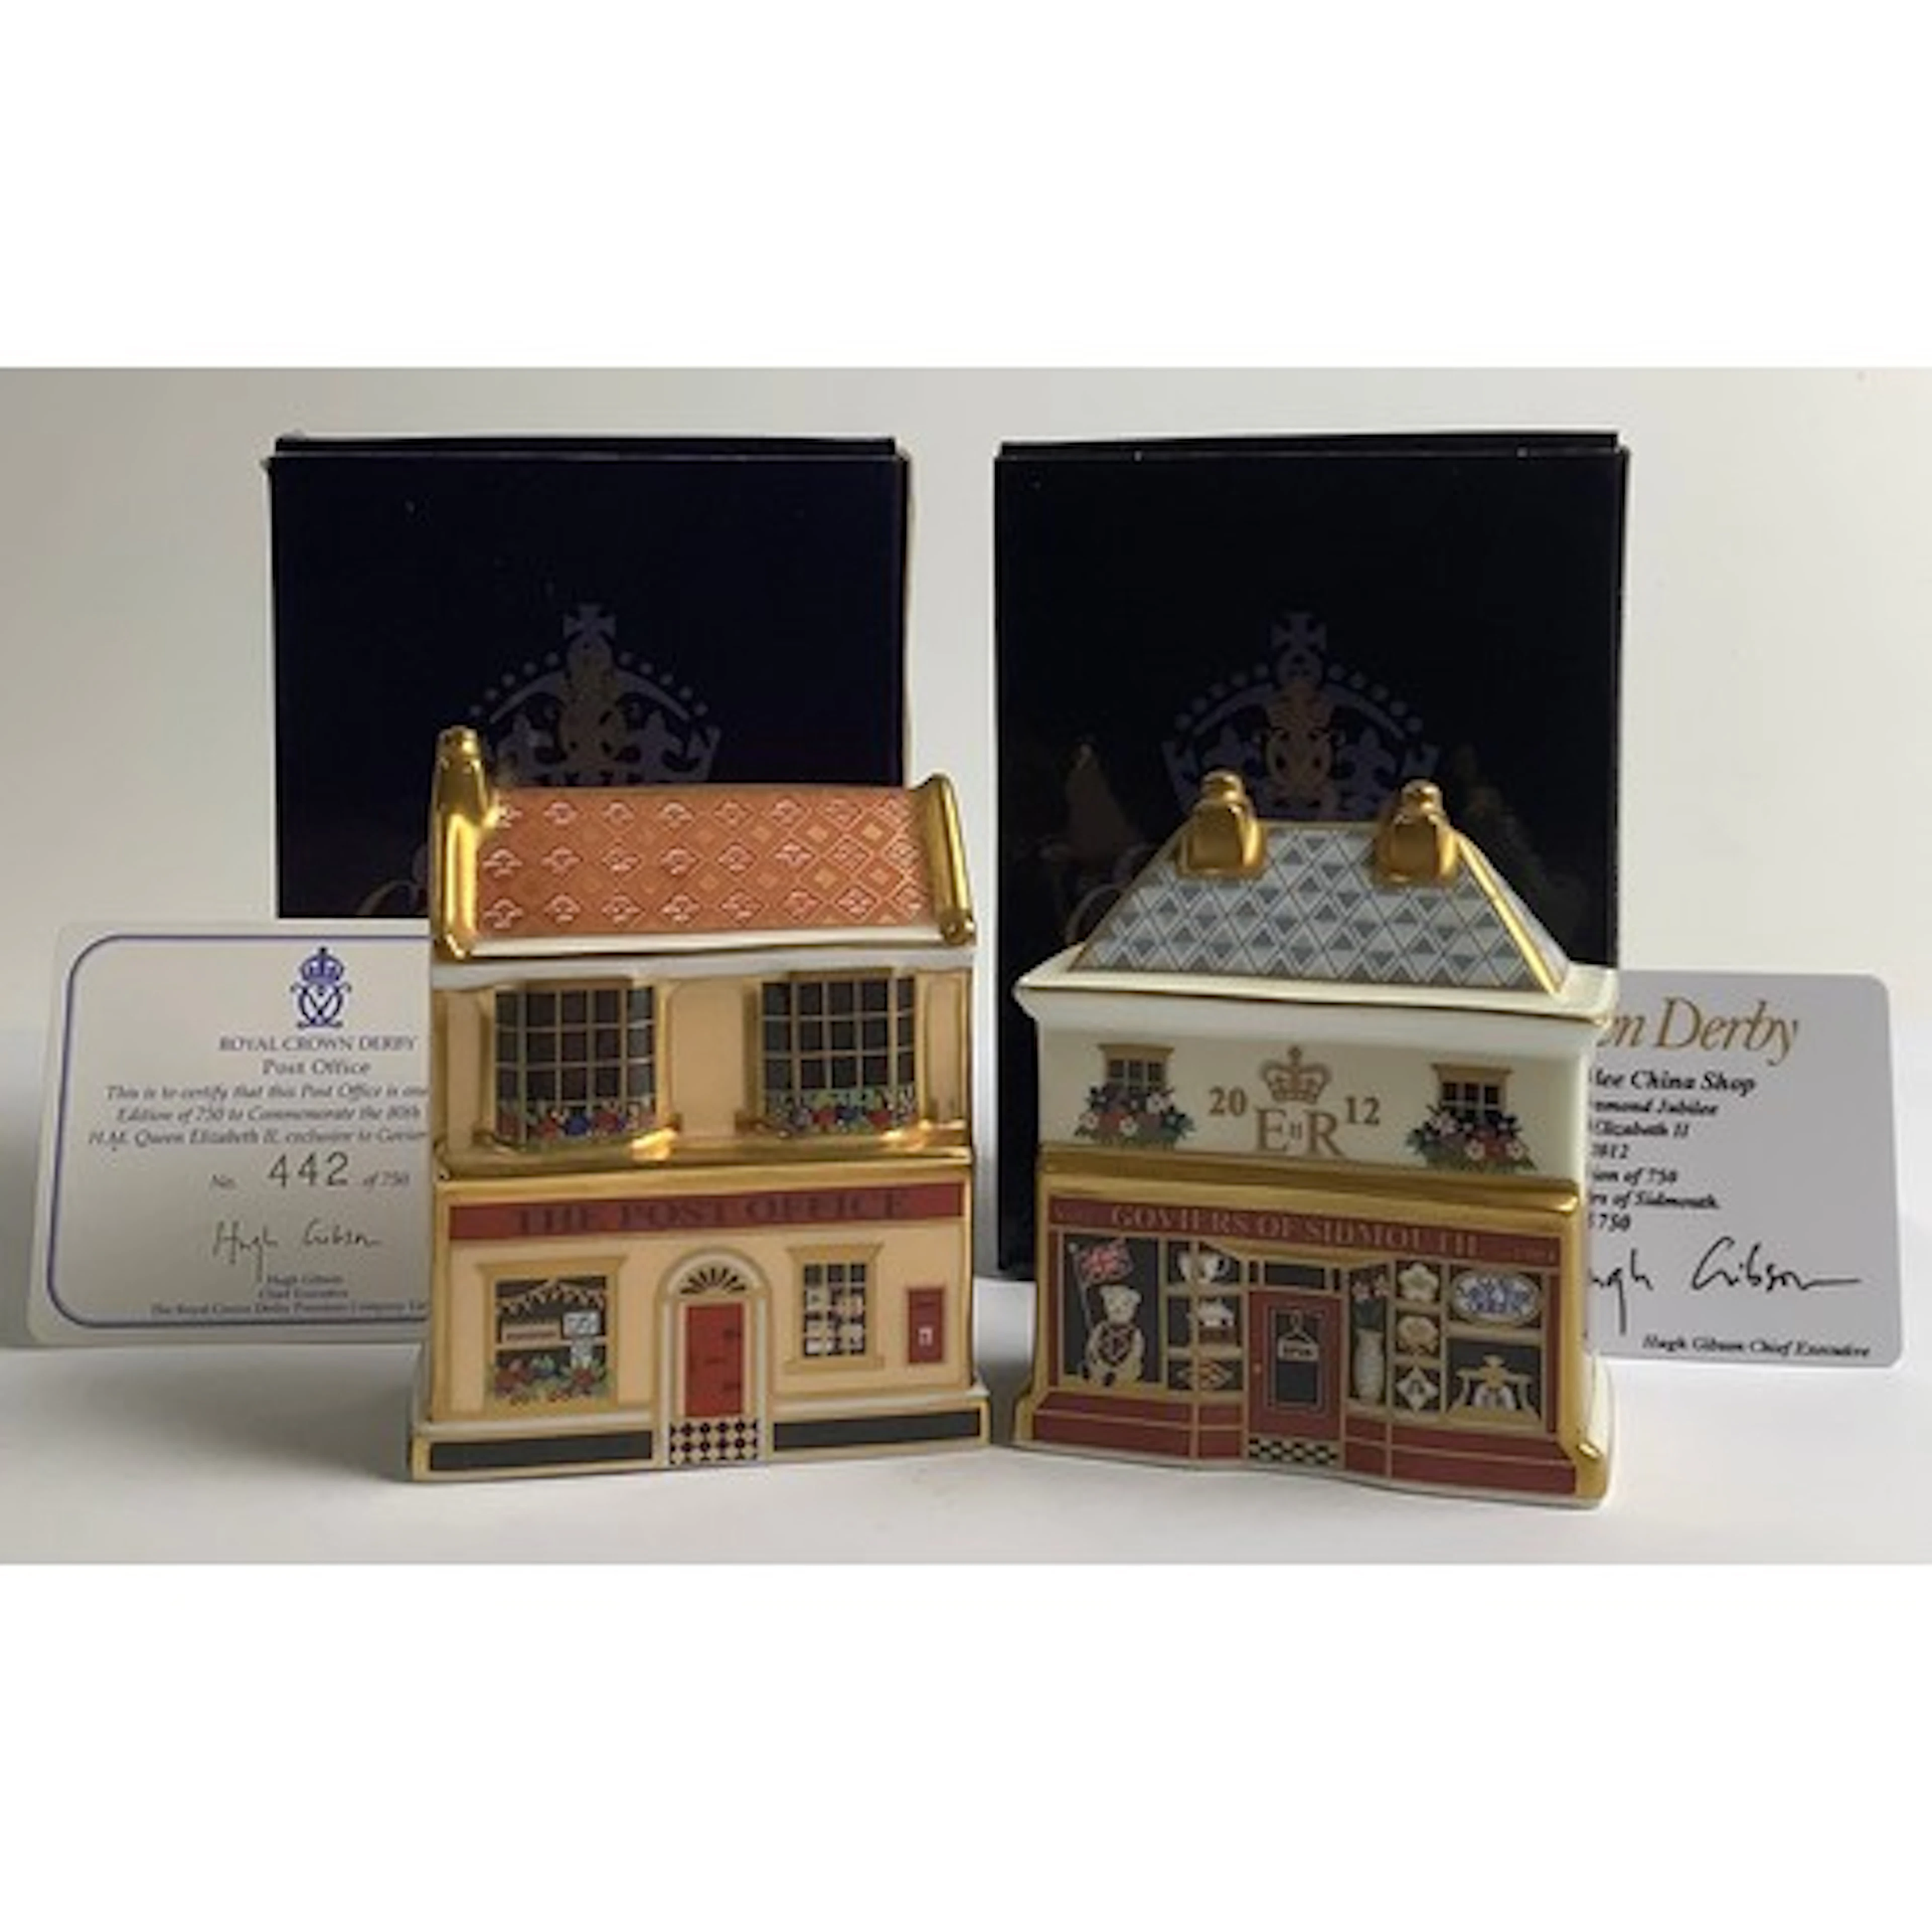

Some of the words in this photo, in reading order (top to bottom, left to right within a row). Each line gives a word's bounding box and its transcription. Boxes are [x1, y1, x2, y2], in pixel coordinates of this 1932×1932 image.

[218, 1035, 278, 1051] ROYAL
[282, 1035, 352, 1051] CROWN
[358, 1035, 417, 1051] DERBY
[1653, 997, 1798, 1066] Derby
[262, 1059, 306, 1076] Post
[311, 1059, 371, 1075] Office
[302, 1084, 333, 1098] Post
[338, 1083, 382, 1101] Office
[1631, 1069, 1696, 1090] China
[1701, 1070, 1756, 1096] Shop
[1209, 1085, 1248, 1117] 20
[1345, 1095, 1381, 1126] 12
[267, 1151, 348, 1189] 442
[1623, 1167, 1645, 1186] of
[1648, 1166, 1678, 1185] 750
[515, 1204, 605, 1238] THE
[621, 1197, 736, 1231] POST
[745, 1189, 909, 1224] OFFICE
[1111, 1204, 1249, 1235] GOVIERS
[1258, 1214, 1297, 1239] OF
[1305, 1218, 1478, 1258] SIDMOUTH
[1642, 1334, 1686, 1353] Hugh
[1749, 1338, 1794, 1357] Chief
